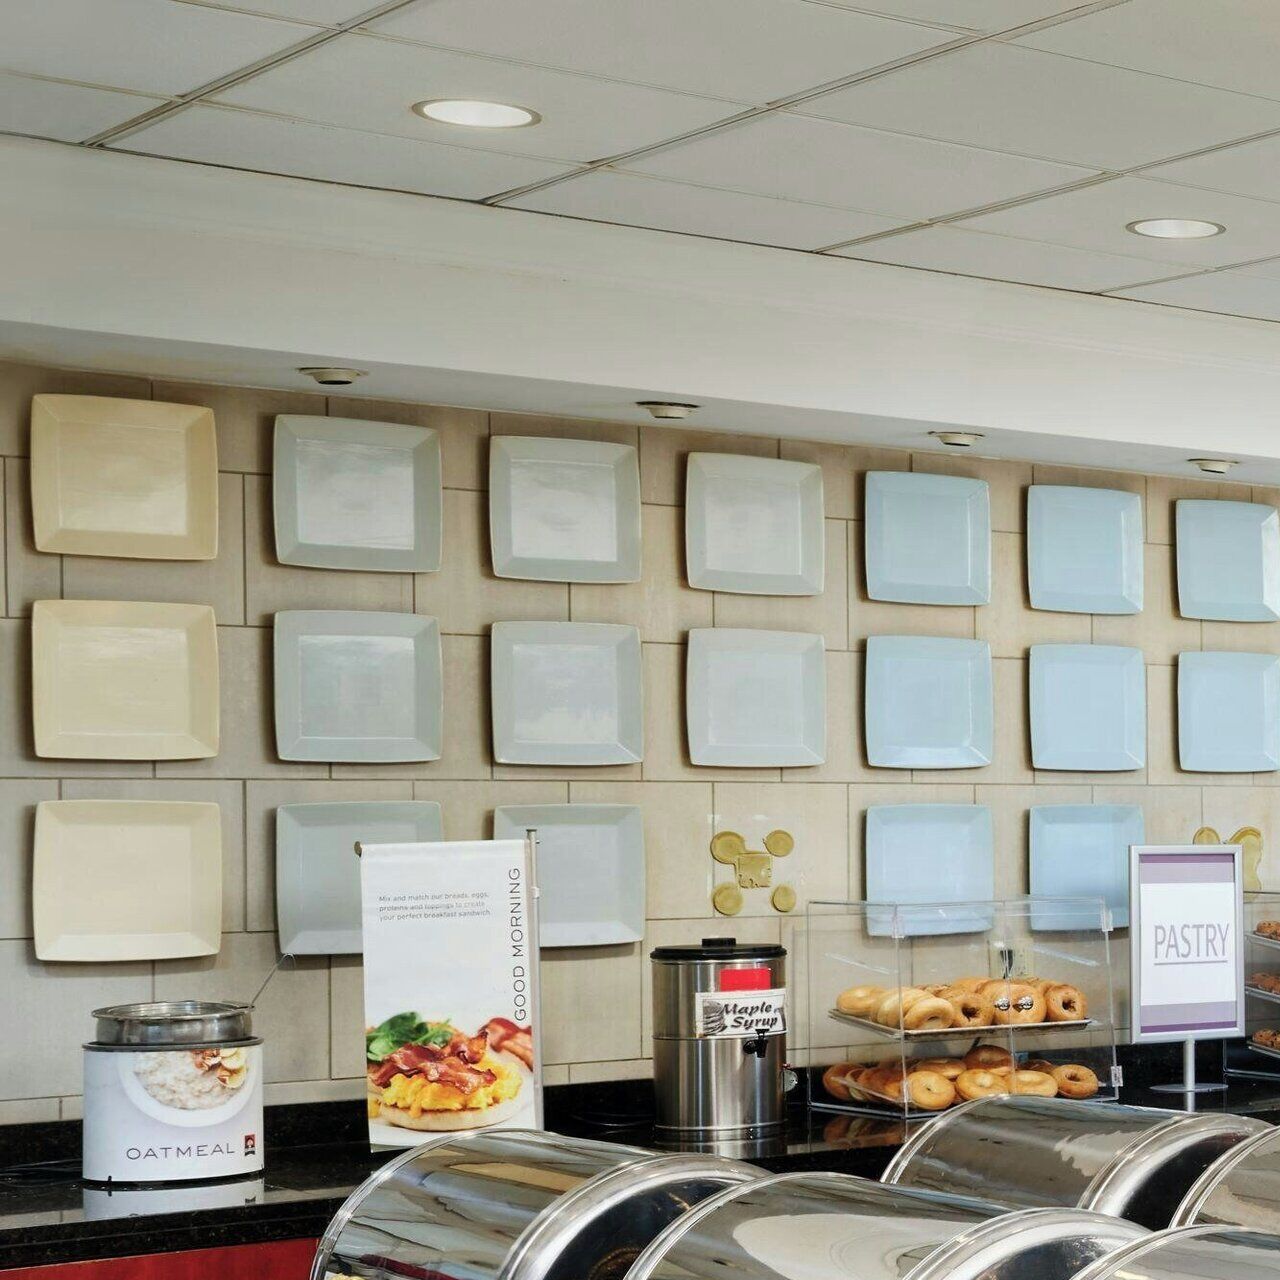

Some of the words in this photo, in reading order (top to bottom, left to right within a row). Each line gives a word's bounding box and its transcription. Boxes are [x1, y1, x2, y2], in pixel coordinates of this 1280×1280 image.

[509, 868, 524, 957] MORNING
[1154, 923, 1230, 959] PASTRY
[513, 965, 527, 1021] GOOD
[722, 1001, 773, 1017] Maple
[731, 1016, 778, 1031] Syrup
[126, 1143, 236, 1161] OATMEAL
